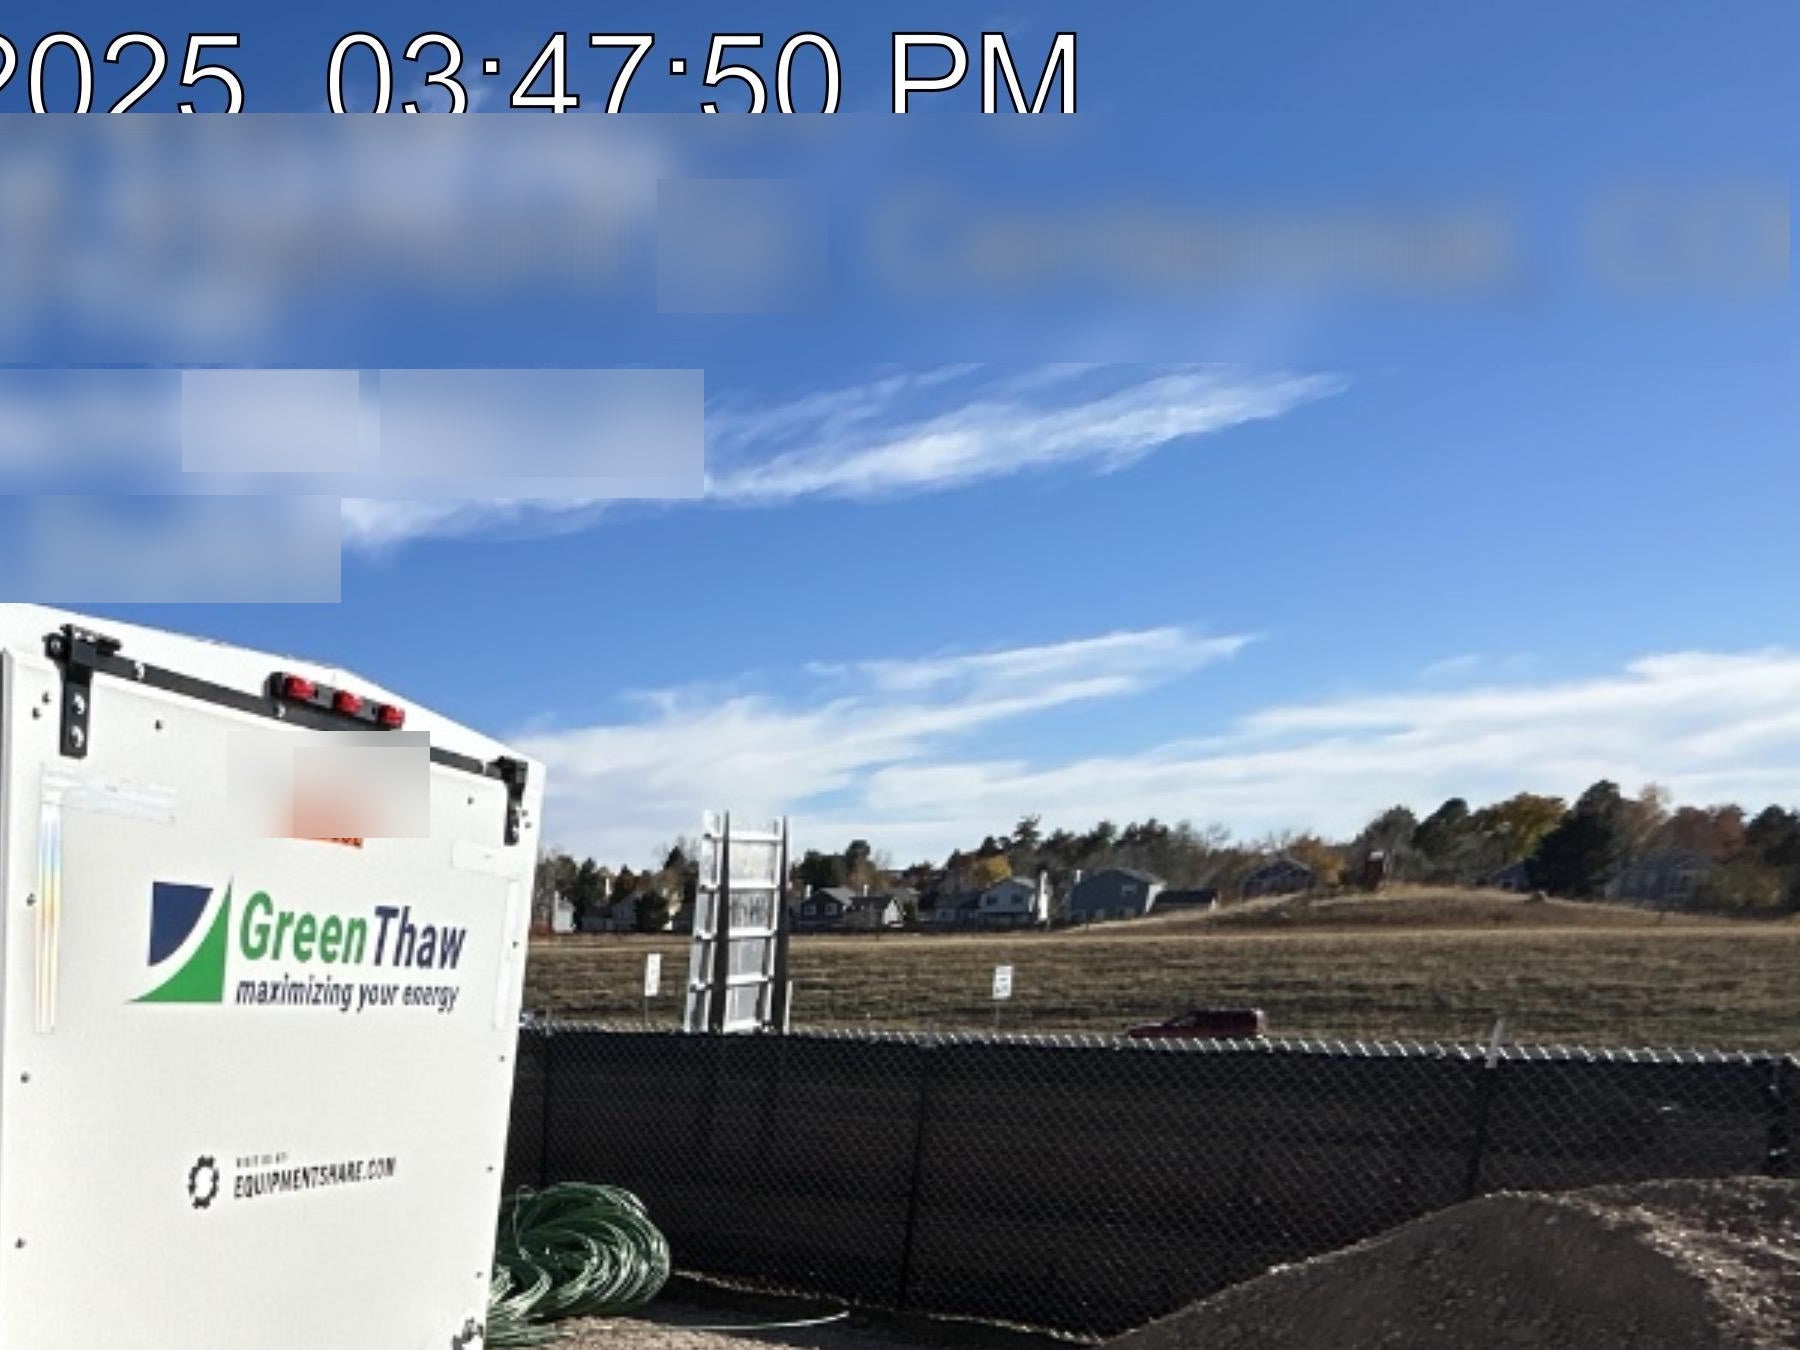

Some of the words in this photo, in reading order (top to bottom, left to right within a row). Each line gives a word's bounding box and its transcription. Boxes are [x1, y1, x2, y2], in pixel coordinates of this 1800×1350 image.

[235, 973, 353, 1011] maximizing
[356, 983, 398, 1012] your
[402, 982, 459, 1013] energy
[233, 1156, 397, 1199] EQUIPMENTSHARE.COM
